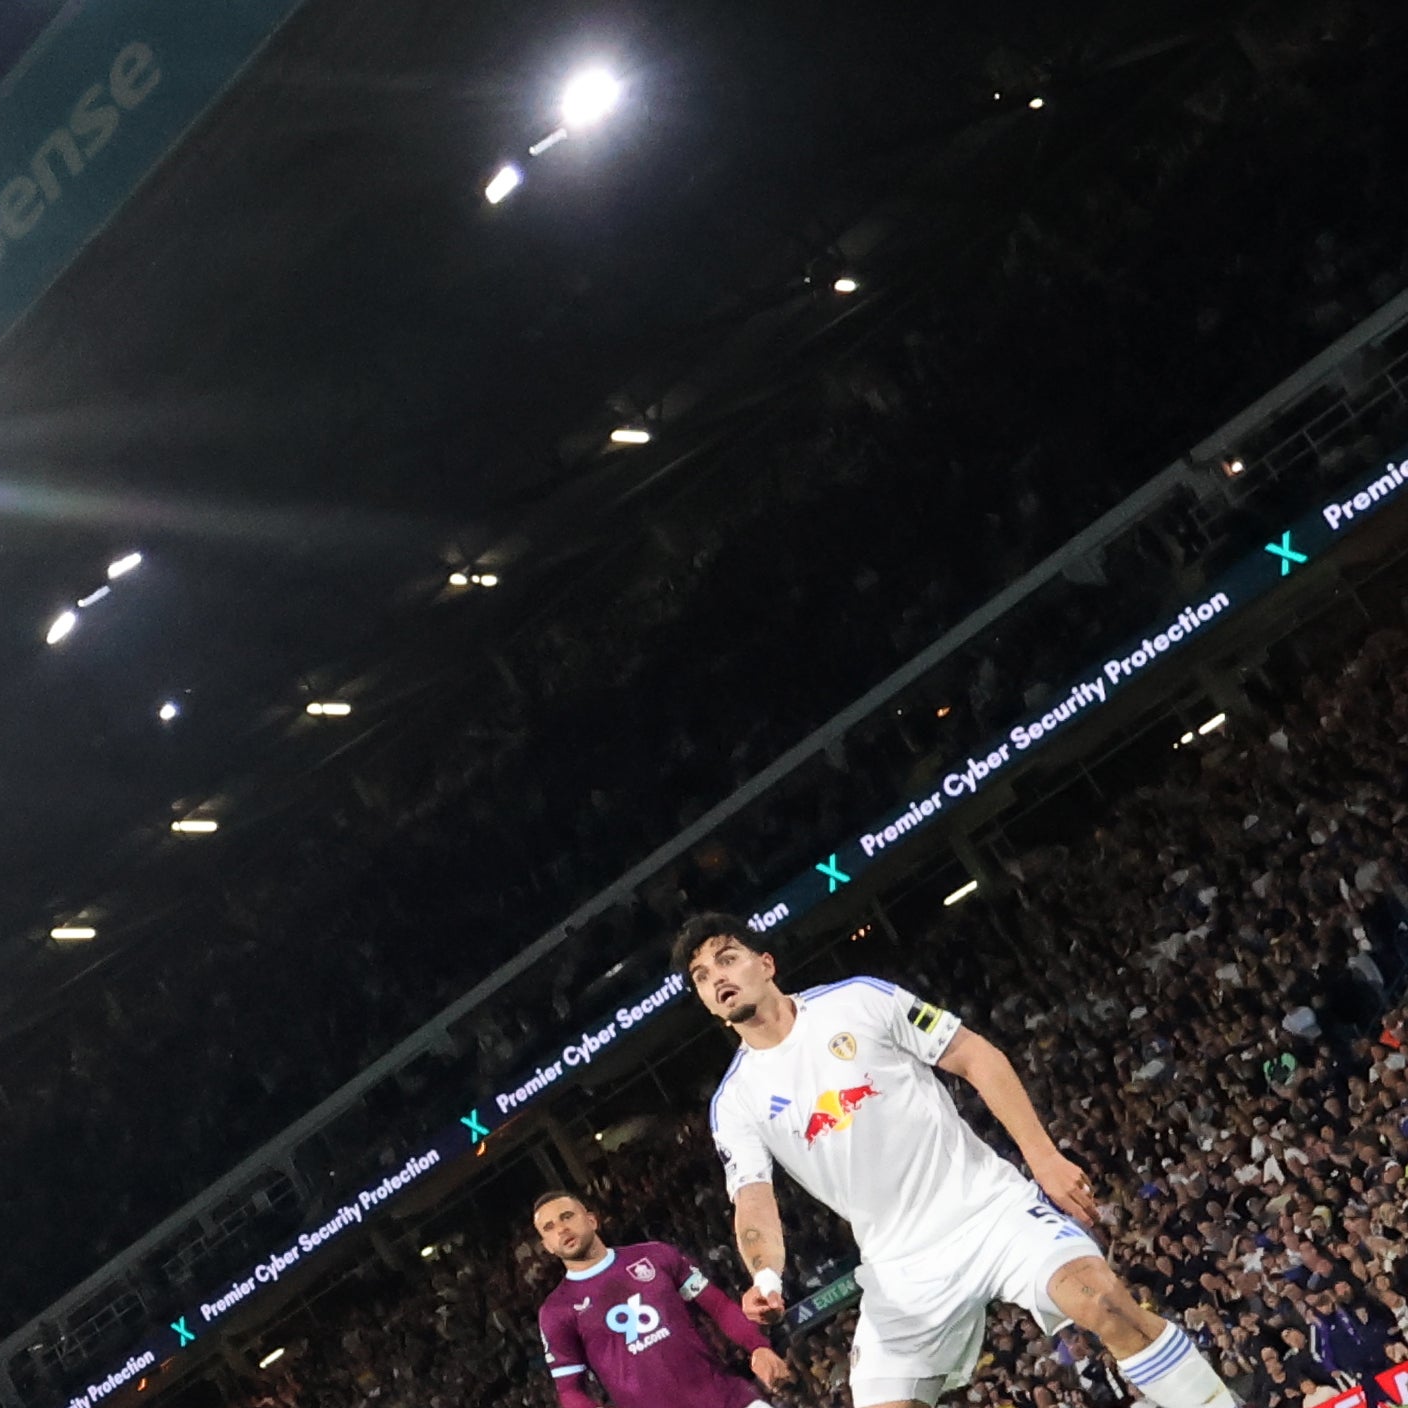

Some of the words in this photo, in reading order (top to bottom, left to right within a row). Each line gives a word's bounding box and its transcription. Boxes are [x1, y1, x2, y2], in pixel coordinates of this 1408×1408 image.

[859, 789, 942, 857] Premier
[942, 740, 1011, 797] Cyber
[1010, 674, 1108, 751] Security
[1103, 592, 1230, 685] Protection
[495, 1059, 563, 1114] Premier
[562, 1022, 617, 1069] Cyber
[615, 971, 691, 1030] Securit
[200, 1277, 255, 1321] Premier
[254, 1245, 299, 1284] Cyber
[298, 1206, 364, 1252] Security
[358, 1148, 440, 1211] Protection
[605, 1293, 660, 1344] 96
[628, 1326, 671, 1355] 96.com
[88, 1350, 155, 1402] Protection
